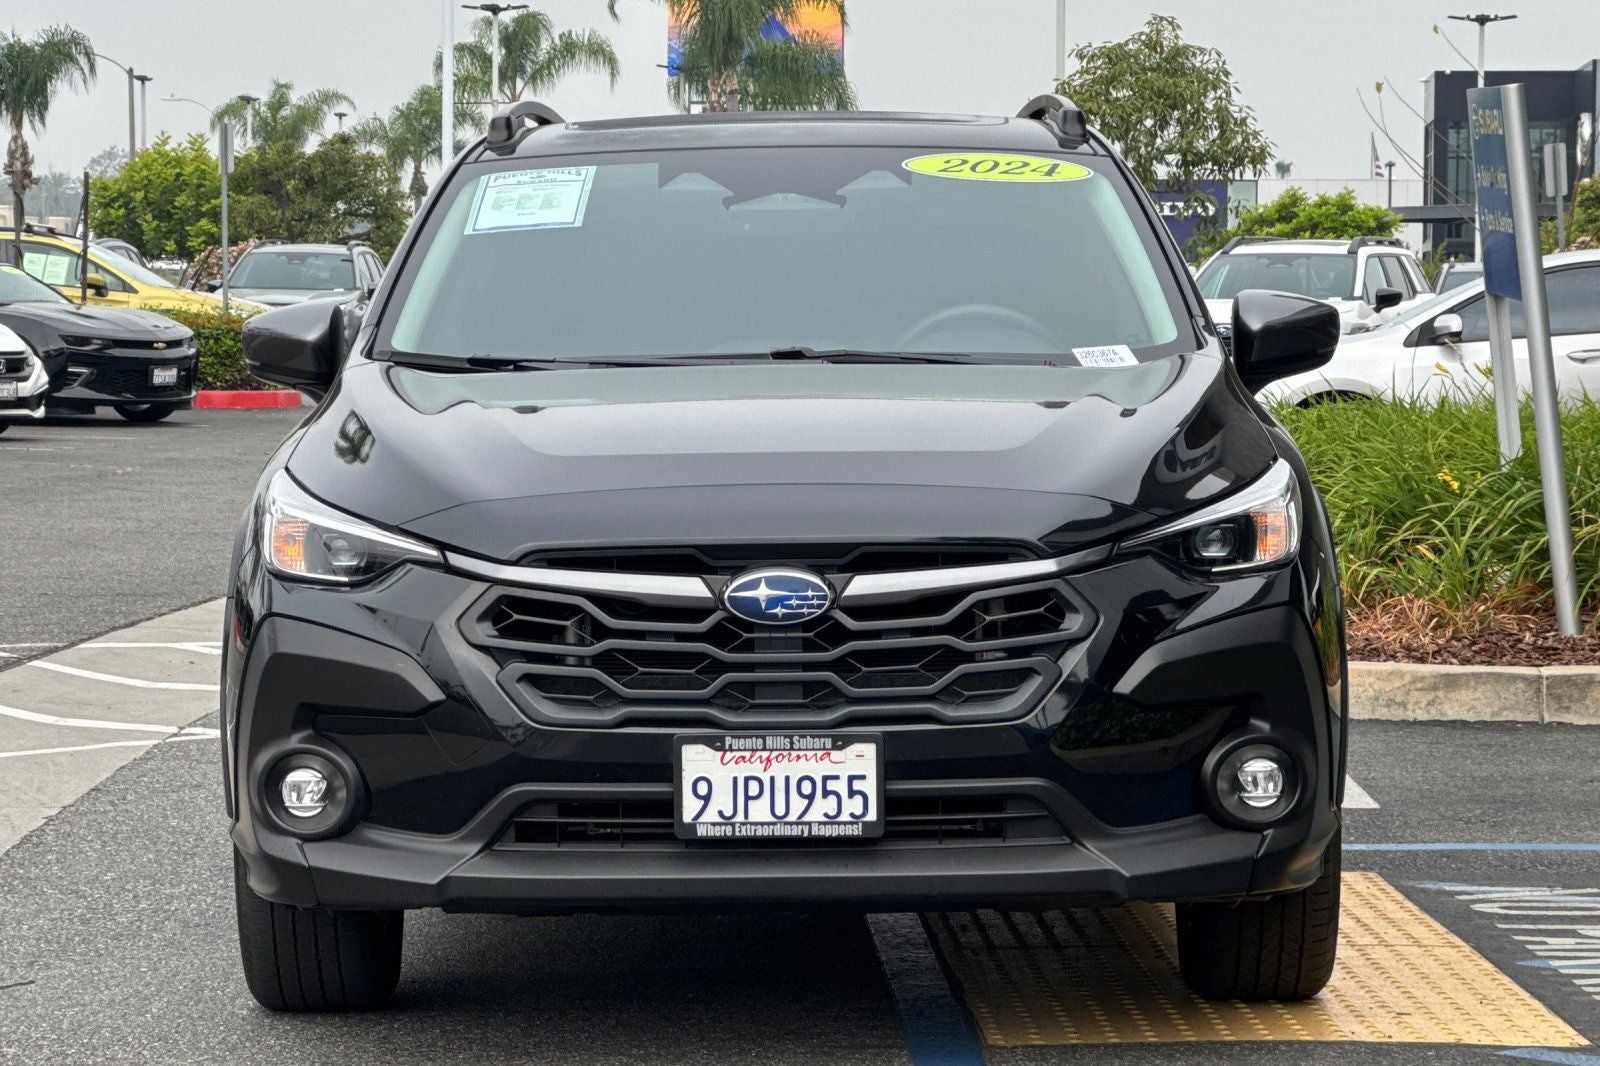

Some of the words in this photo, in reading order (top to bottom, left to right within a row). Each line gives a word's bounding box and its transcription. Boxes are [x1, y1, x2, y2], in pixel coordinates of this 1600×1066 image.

[937, 157, 1061, 177] 2024
[725, 736, 763, 749] Puente
[766, 736, 791, 749] Hills
[793, 736, 832, 749] Subaru
[720, 750, 846, 772] California
[691, 774, 869, 821] 9JPU955
[696, 824, 732, 836] Where
[735, 824, 809, 837] Extraordinary
[811, 823, 862, 836] Happens!
